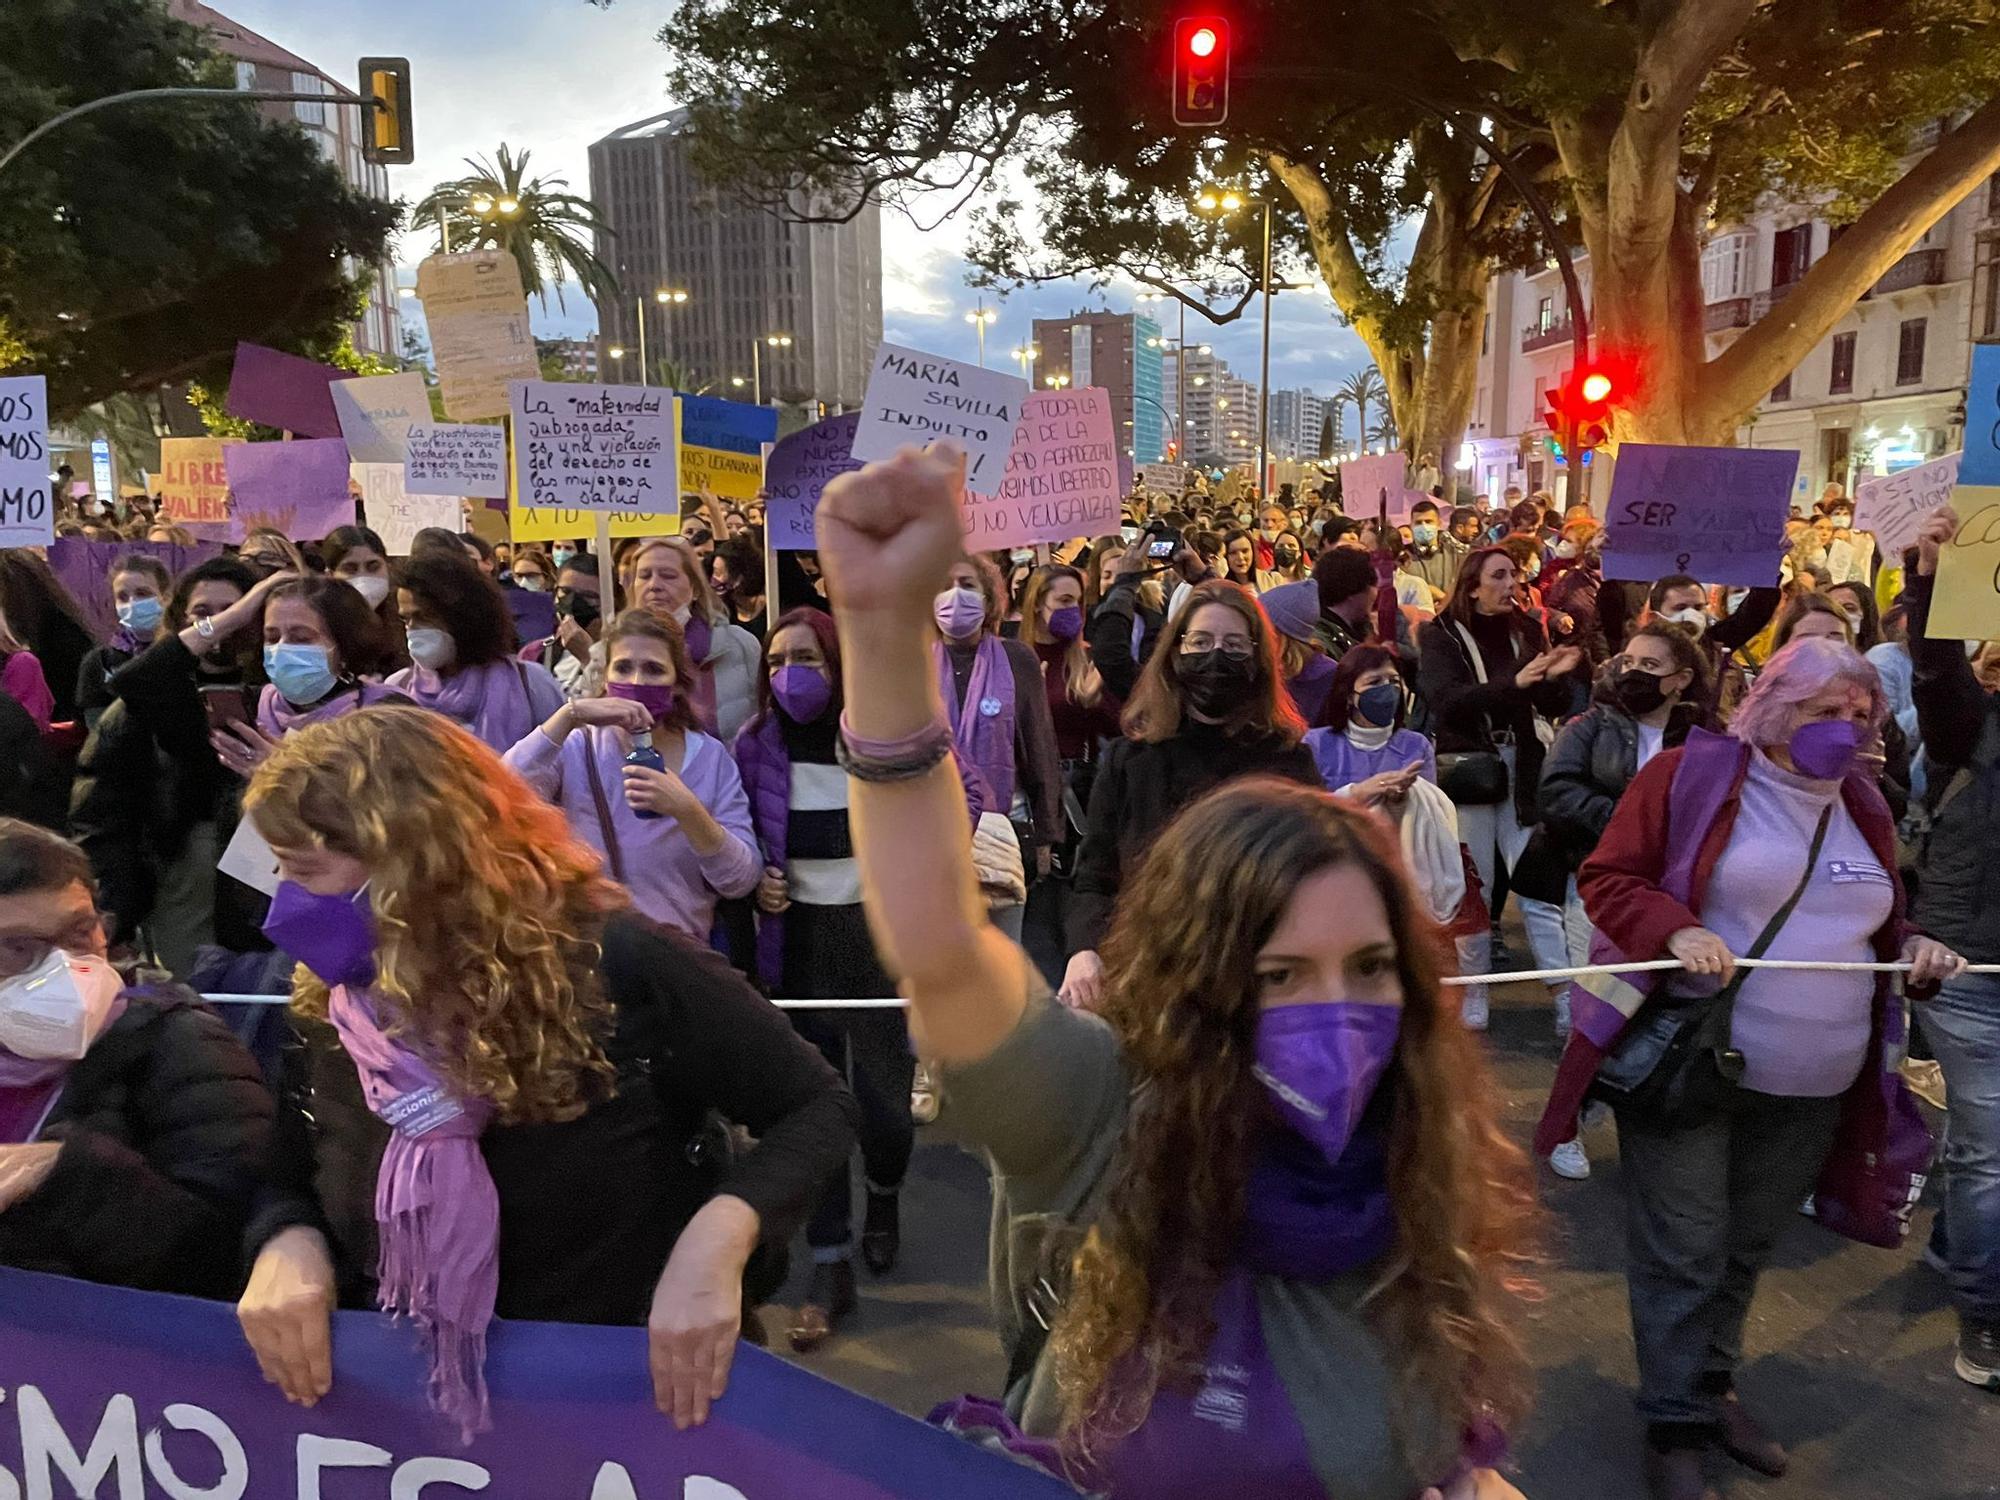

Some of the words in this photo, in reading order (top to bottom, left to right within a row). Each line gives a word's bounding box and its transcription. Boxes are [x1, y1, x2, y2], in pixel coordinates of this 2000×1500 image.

[524, 386, 554, 414] La
[923, 391, 1009, 422] SEVILLA
[1039, 398, 1078, 418] TODA
[1080, 398, 1098, 415] LA
[811, 425, 839, 442] NO
[878, 407, 988, 442] INDULTO
[1039, 423, 1058, 443] DE
[1065, 420, 1088, 439] LA
[529, 442, 548, 454] es
[559, 442, 593, 454] una
[529, 452, 553, 470] del
[562, 453, 626, 470] derecho
[632, 455, 652, 469] de
[166, 462, 226, 485] LIBRE
[530, 470, 557, 488] las
[565, 471, 633, 493] mujeres
[638, 477, 652, 489] a
[1051, 466, 1112, 494] LIBERTAD
[534, 488, 562, 505] la
[580, 487, 640, 505] salud
[773, 485, 800, 499] NO
[985, 510, 1007, 533] NO
[1018, 495, 1114, 528] VENGANZA
[1617, 501, 1677, 527] SER
[0, 1383, 249, 1500] MO
